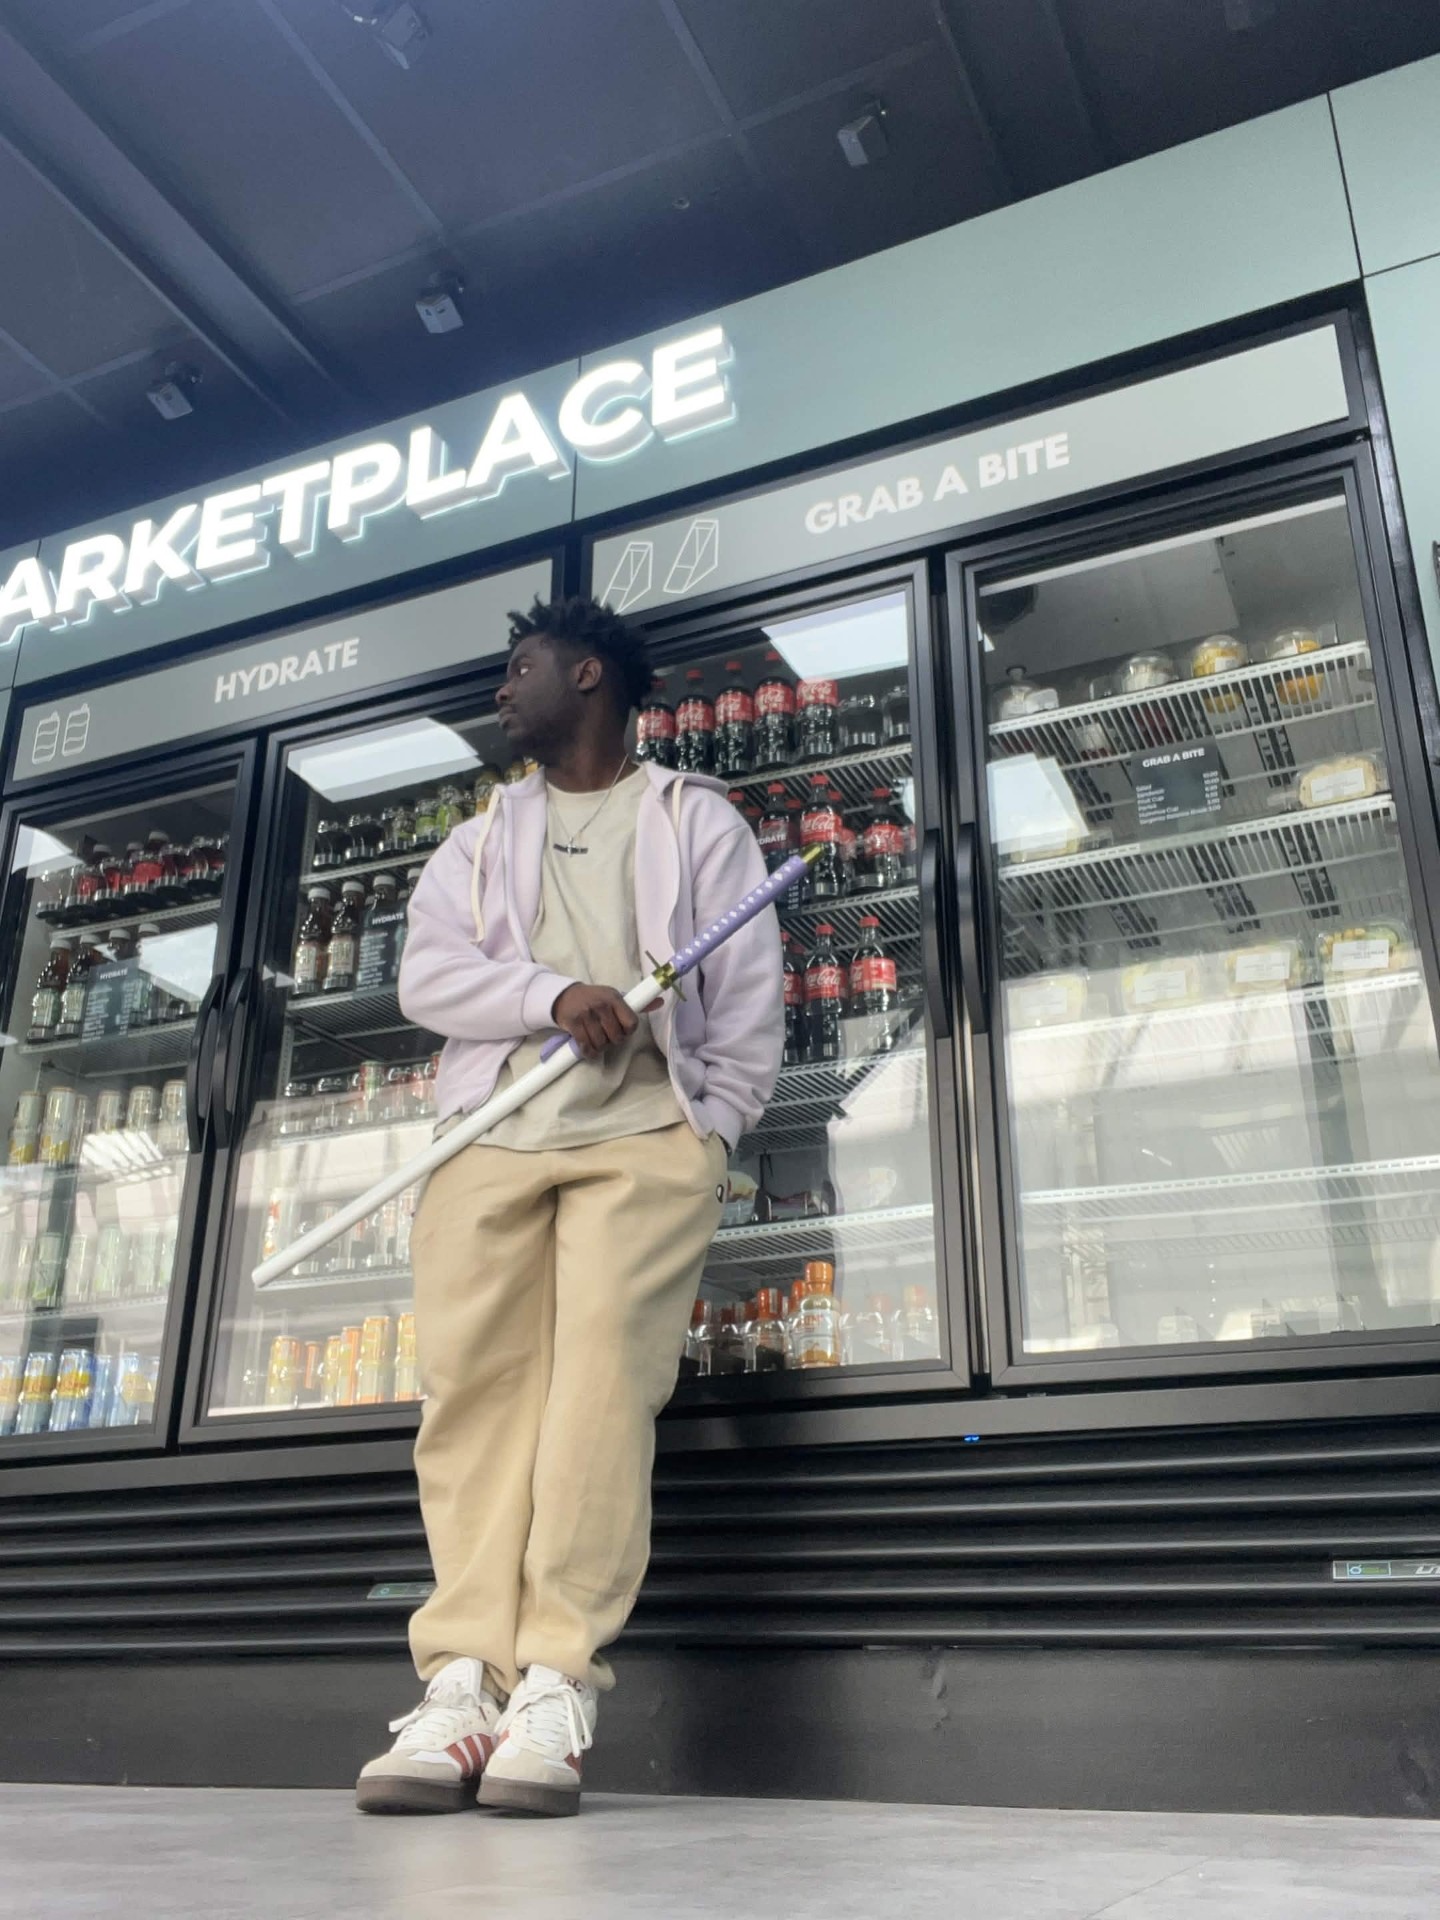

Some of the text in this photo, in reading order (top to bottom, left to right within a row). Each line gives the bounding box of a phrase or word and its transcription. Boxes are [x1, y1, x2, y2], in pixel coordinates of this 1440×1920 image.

[0, 325, 730, 626] ARKETPLACE
[804, 432, 1071, 534] GRAB A BITE
[214, 636, 361, 704] HYDRATE
[1142, 747, 1205, 768] GRAB A BITE
[757, 833, 787, 846] DRATE
[371, 912, 405, 925] HYDRATE
